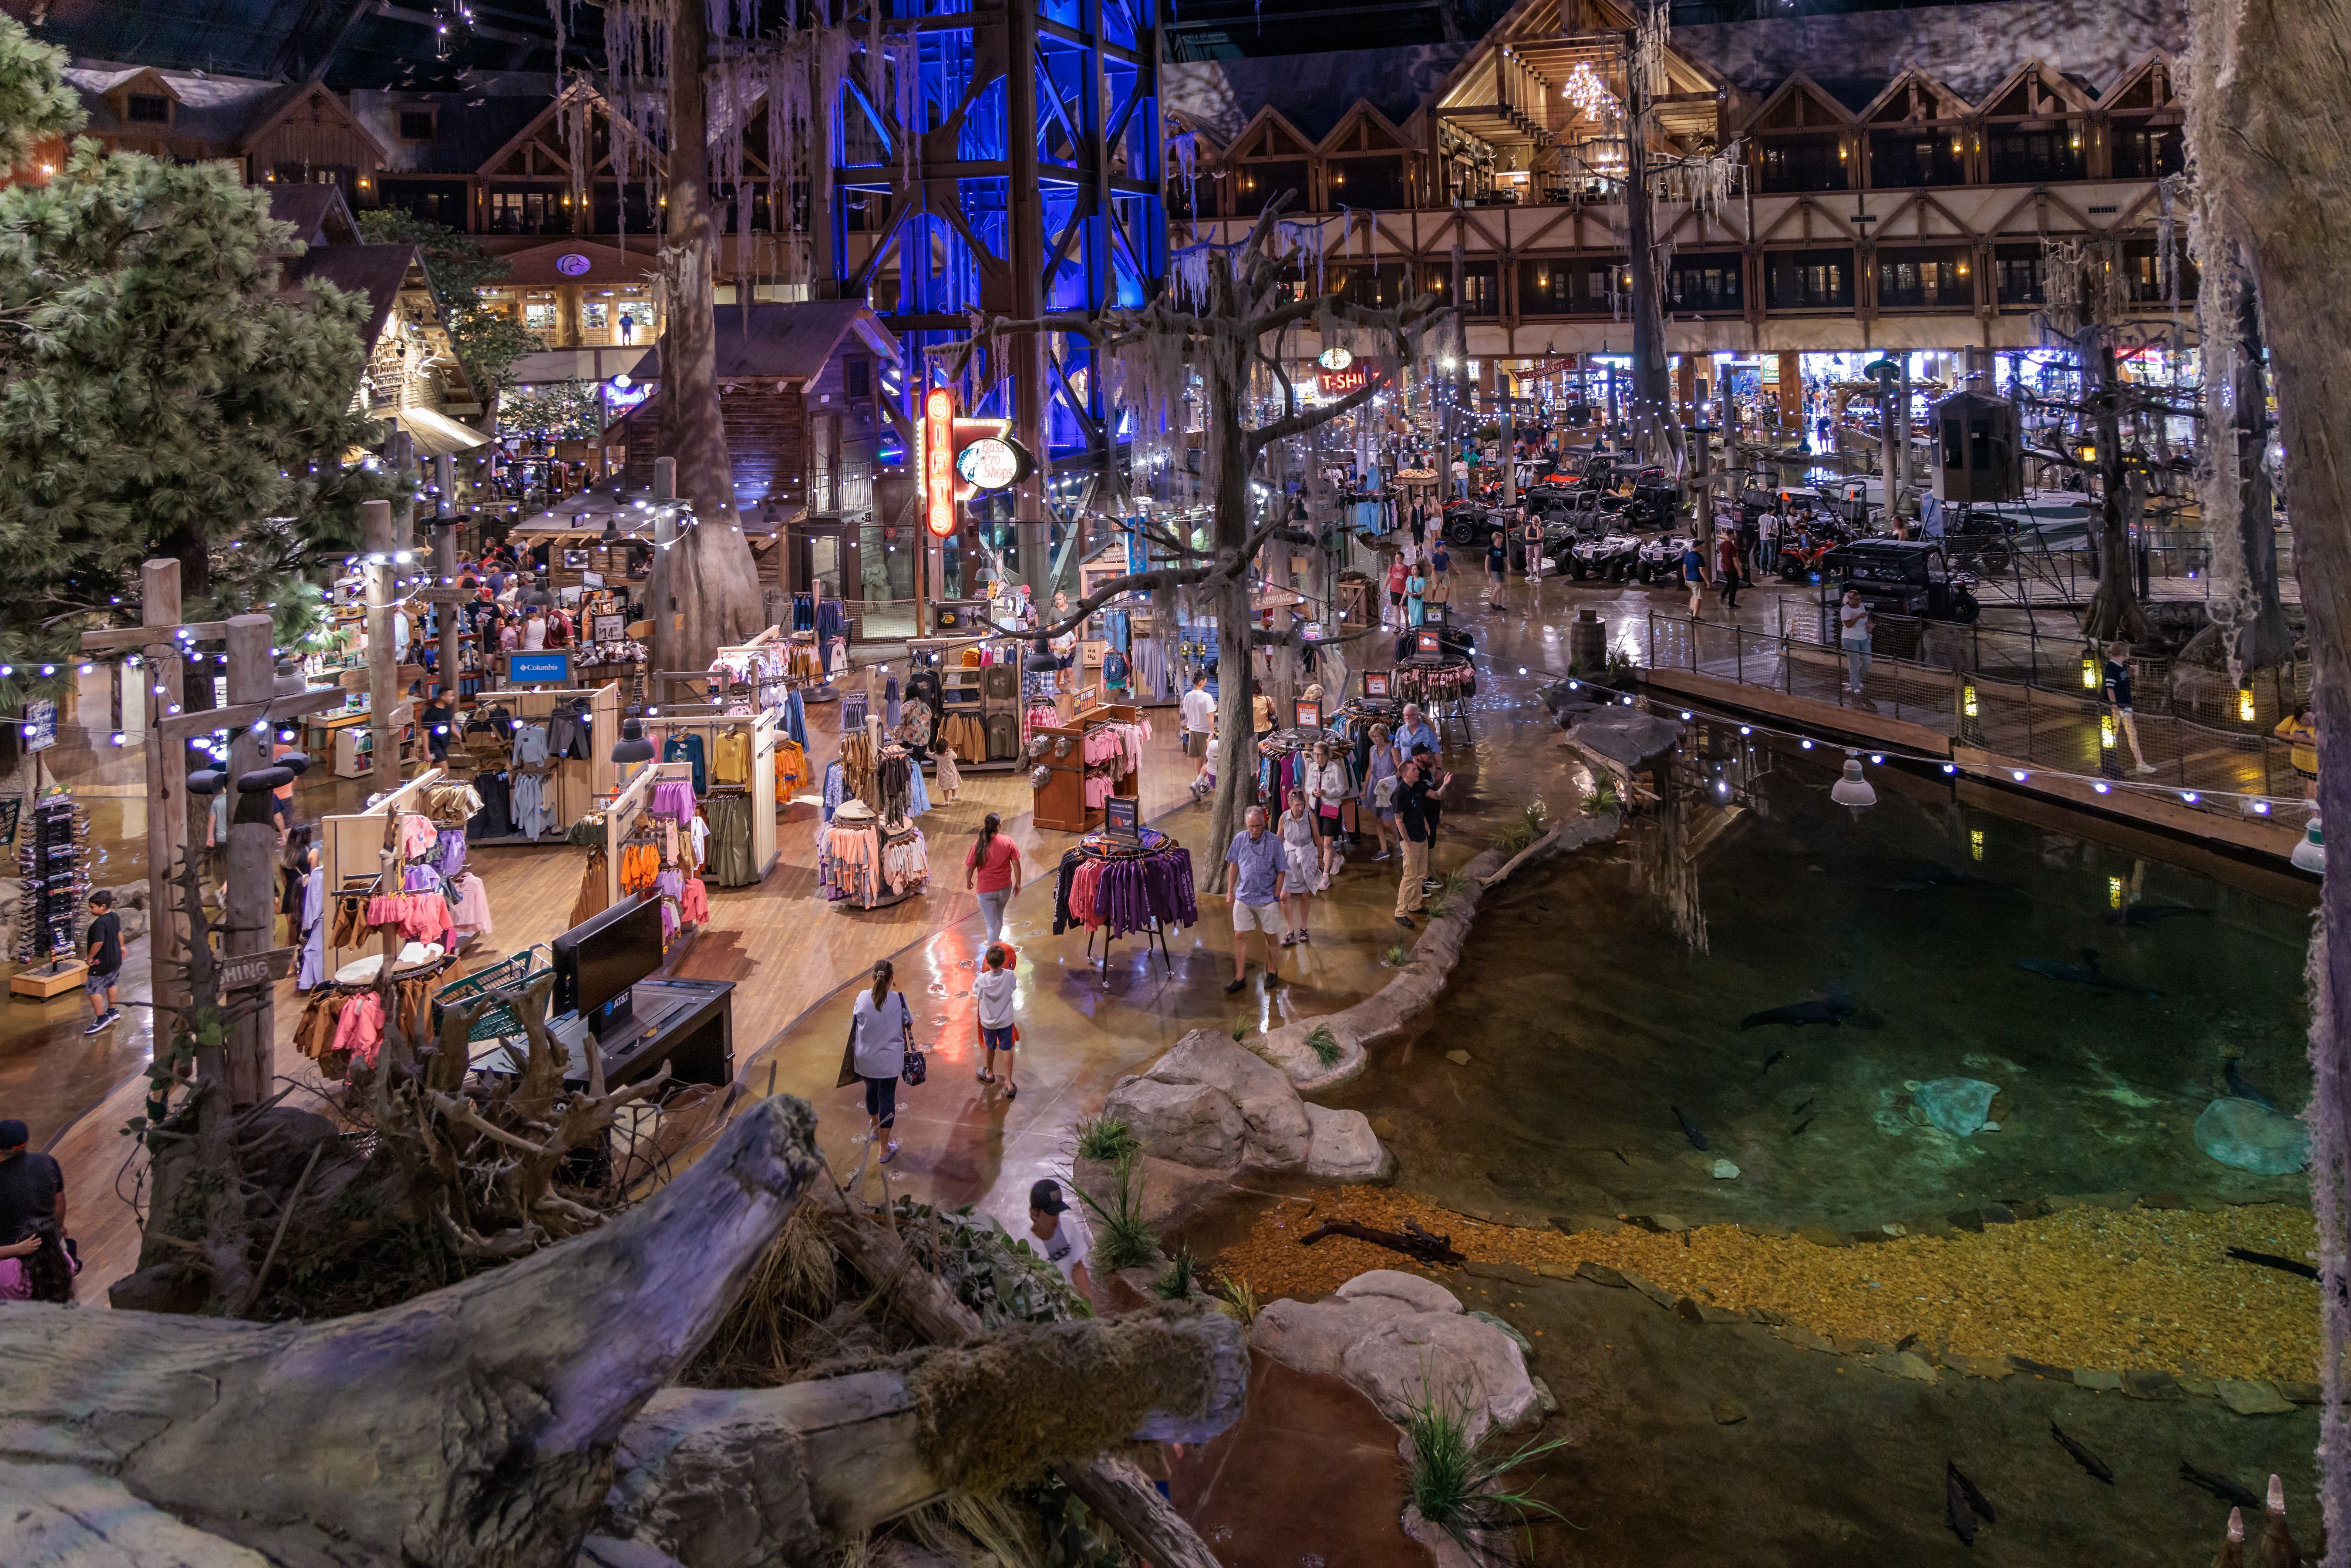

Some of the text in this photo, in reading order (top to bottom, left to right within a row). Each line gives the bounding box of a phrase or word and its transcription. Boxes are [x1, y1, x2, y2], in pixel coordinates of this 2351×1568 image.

[1527, 363, 1564, 378] CONSERVE
[1322, 371, 1391, 390] T-SHIT
[981, 439, 1004, 452] Bass
[929, 396, 949, 530] GIFTS
[983, 452, 1000, 464] Pro
[983, 464, 1013, 481] Shops
[1256, 593, 1292, 606] CAMPING
[1080, 688, 1095, 701] MY FIRST
[1081, 696, 1095, 711] CAMO
[614, 992, 629, 1009] AT&T
